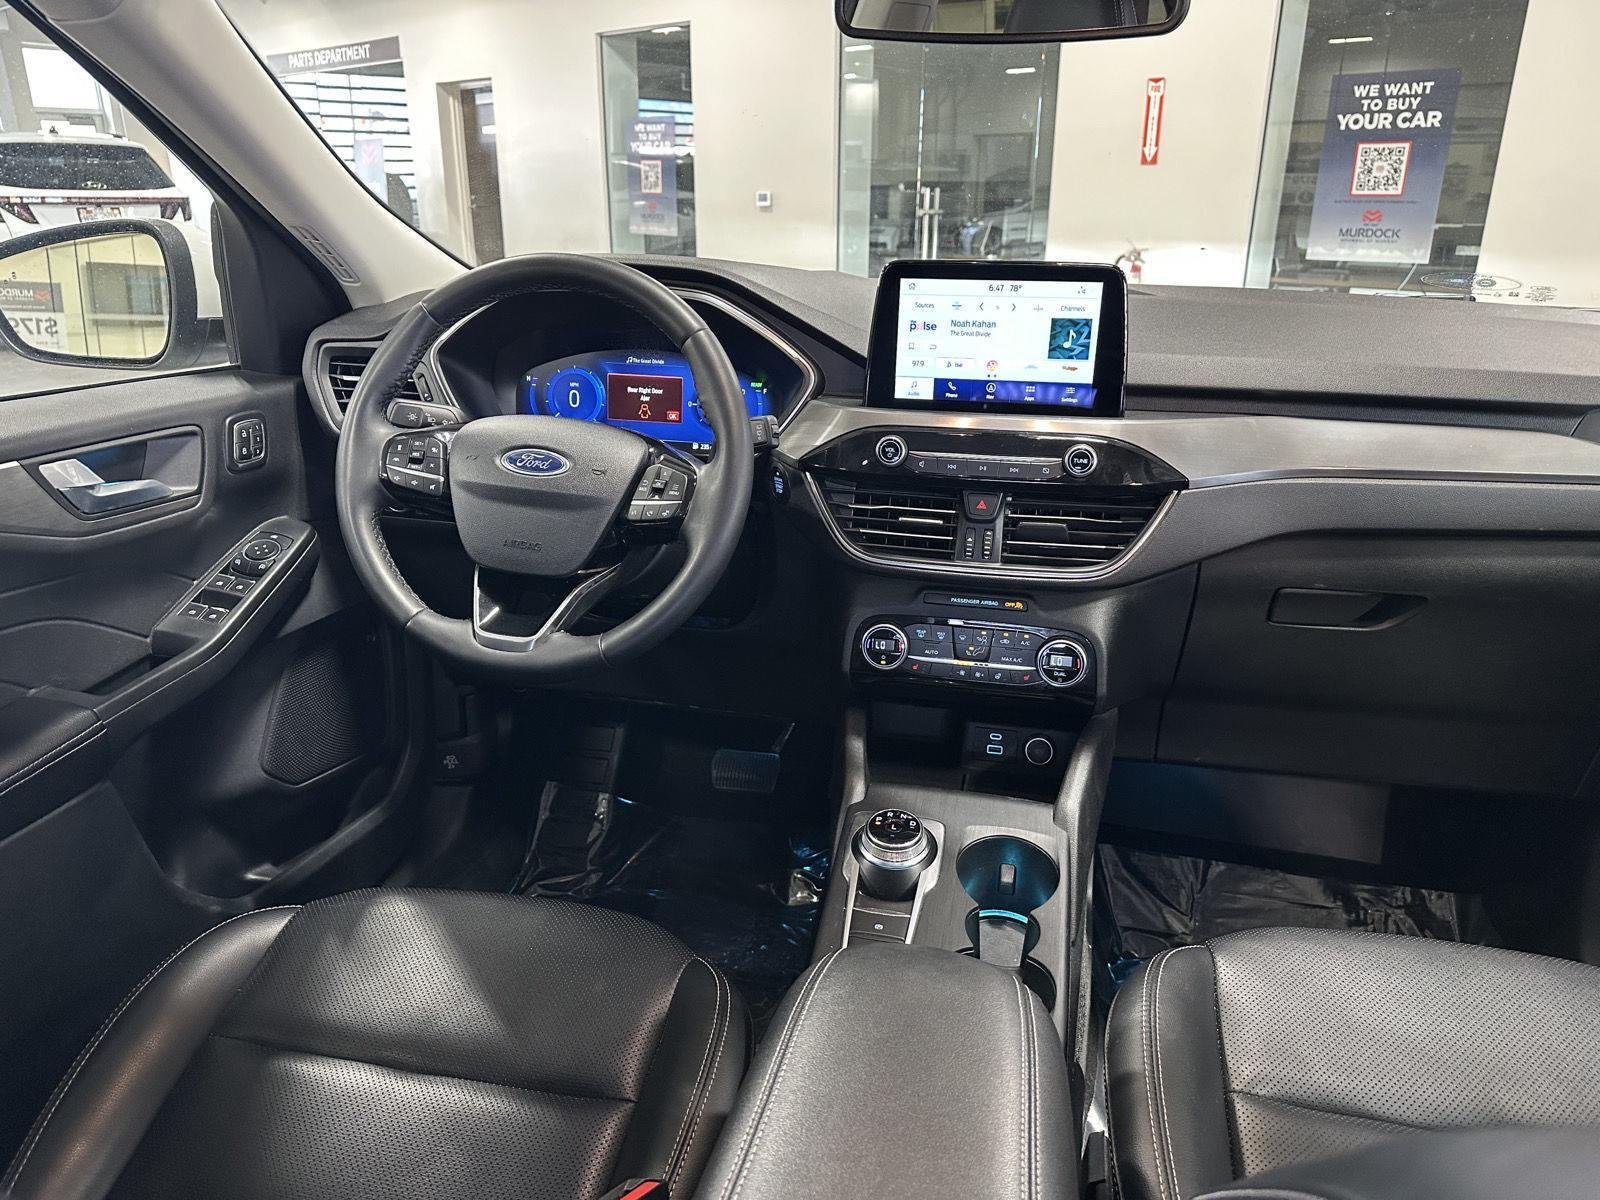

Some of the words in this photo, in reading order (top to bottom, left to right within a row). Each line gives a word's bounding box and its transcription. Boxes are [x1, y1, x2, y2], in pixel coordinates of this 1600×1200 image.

[288, 52, 314, 68] PARTS
[315, 44, 371, 65] DEPARTMENT
[1353, 84, 1380, 98] WE
[1384, 81, 1435, 96] WANT
[1361, 99, 1382, 111] TO
[1386, 97, 1422, 111] BUY
[1337, 113, 1393, 131] YOUR
[1396, 111, 1443, 128] CAR
[1339, 227, 1401, 239] MURDOCK
[950, 319, 970, 328] Noah
[971, 320, 997, 328] Kahan
[569, 389, 580, 408] 0
[639, 387, 651, 395] Right
[516, 453, 552, 470] Ford
[950, 597, 980, 605] PASSENGER
